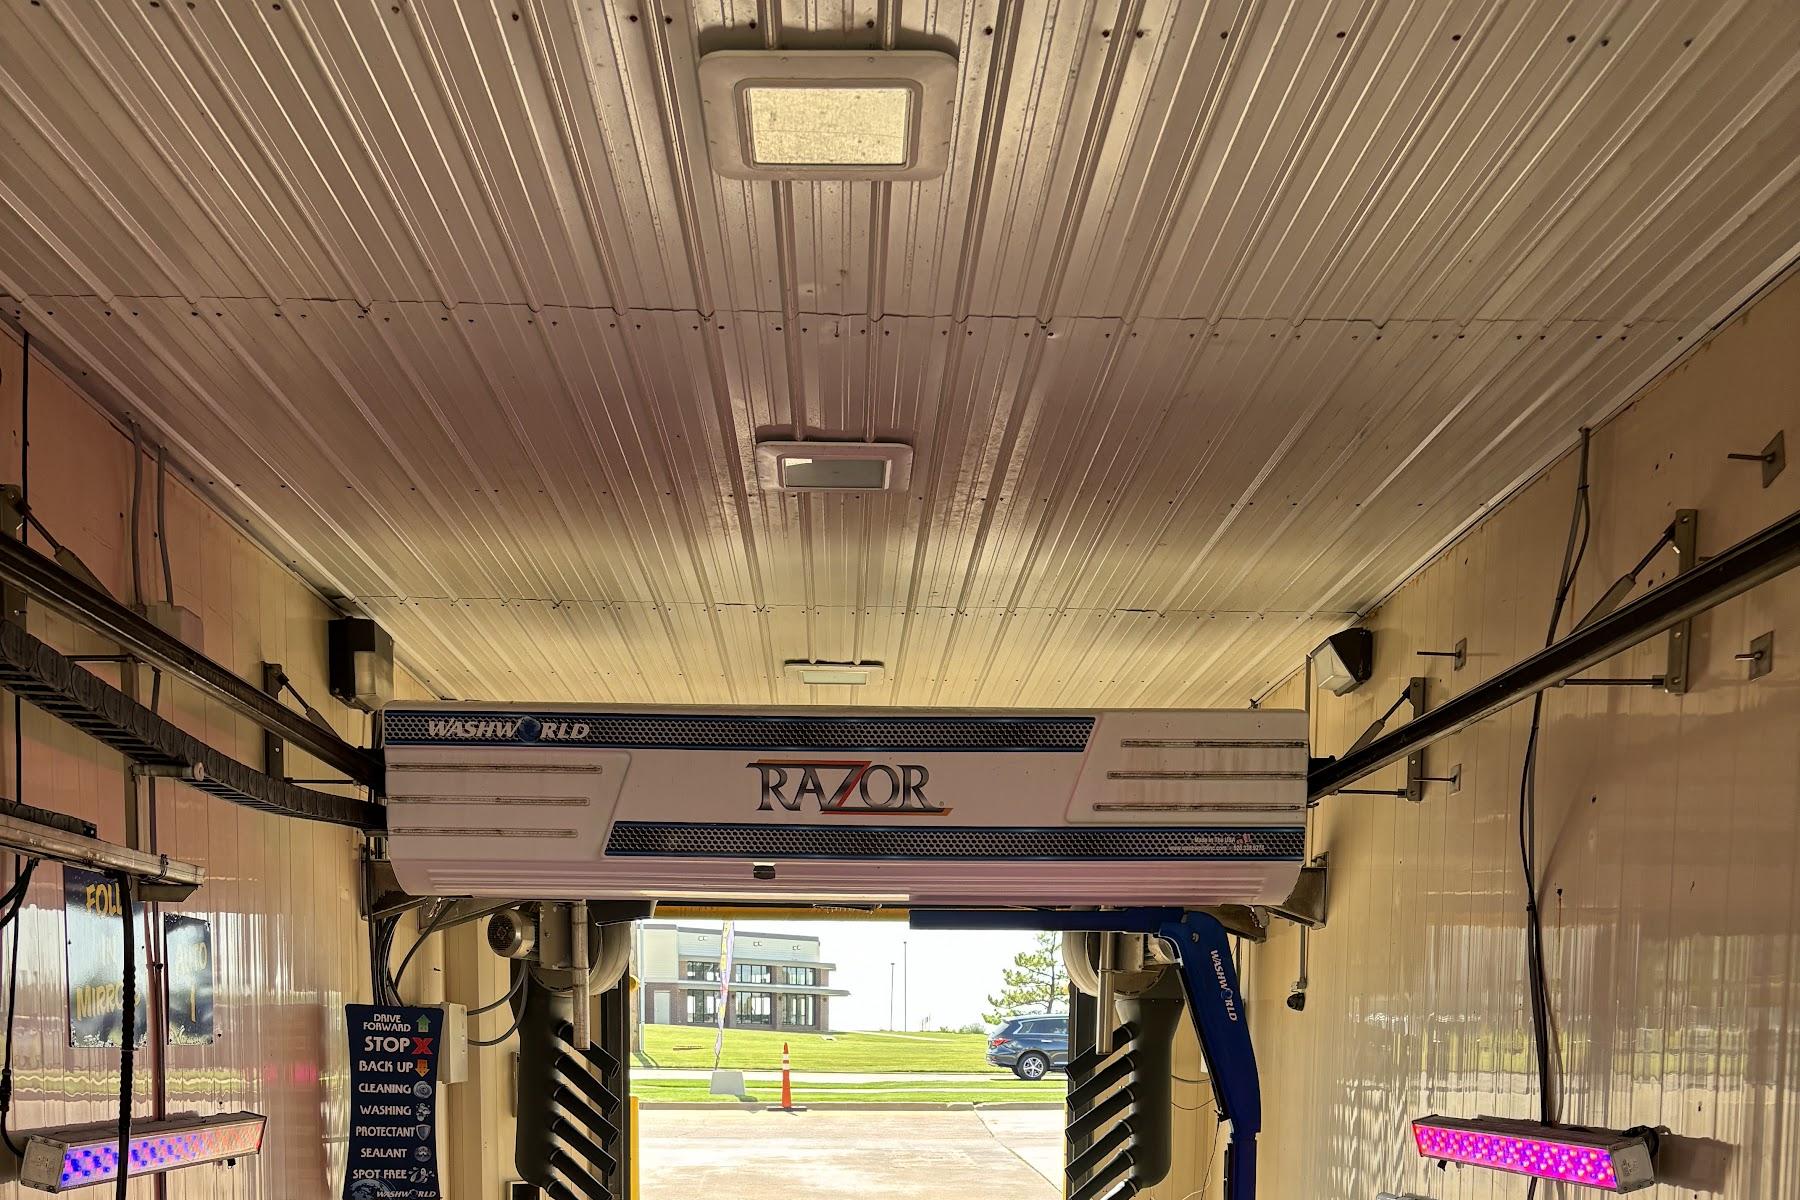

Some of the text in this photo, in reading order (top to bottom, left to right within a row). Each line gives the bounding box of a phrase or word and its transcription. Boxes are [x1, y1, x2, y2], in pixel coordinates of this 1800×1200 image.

[746, 760, 952, 815] RAZOR
[373, 1013, 402, 1024] DRIVE
[363, 1022, 412, 1033] FORWARD
[364, 1036, 411, 1053] STOP
[358, 1059, 414, 1073] BACK UP
[358, 1082, 412, 1095] CLEANING
[360, 1105, 412, 1116] WASHING
[355, 1126, 416, 1138] PROTECTANT
[360, 1148, 408, 1159] SEALANT
[352, 1169, 408, 1180] SPOT FREE
